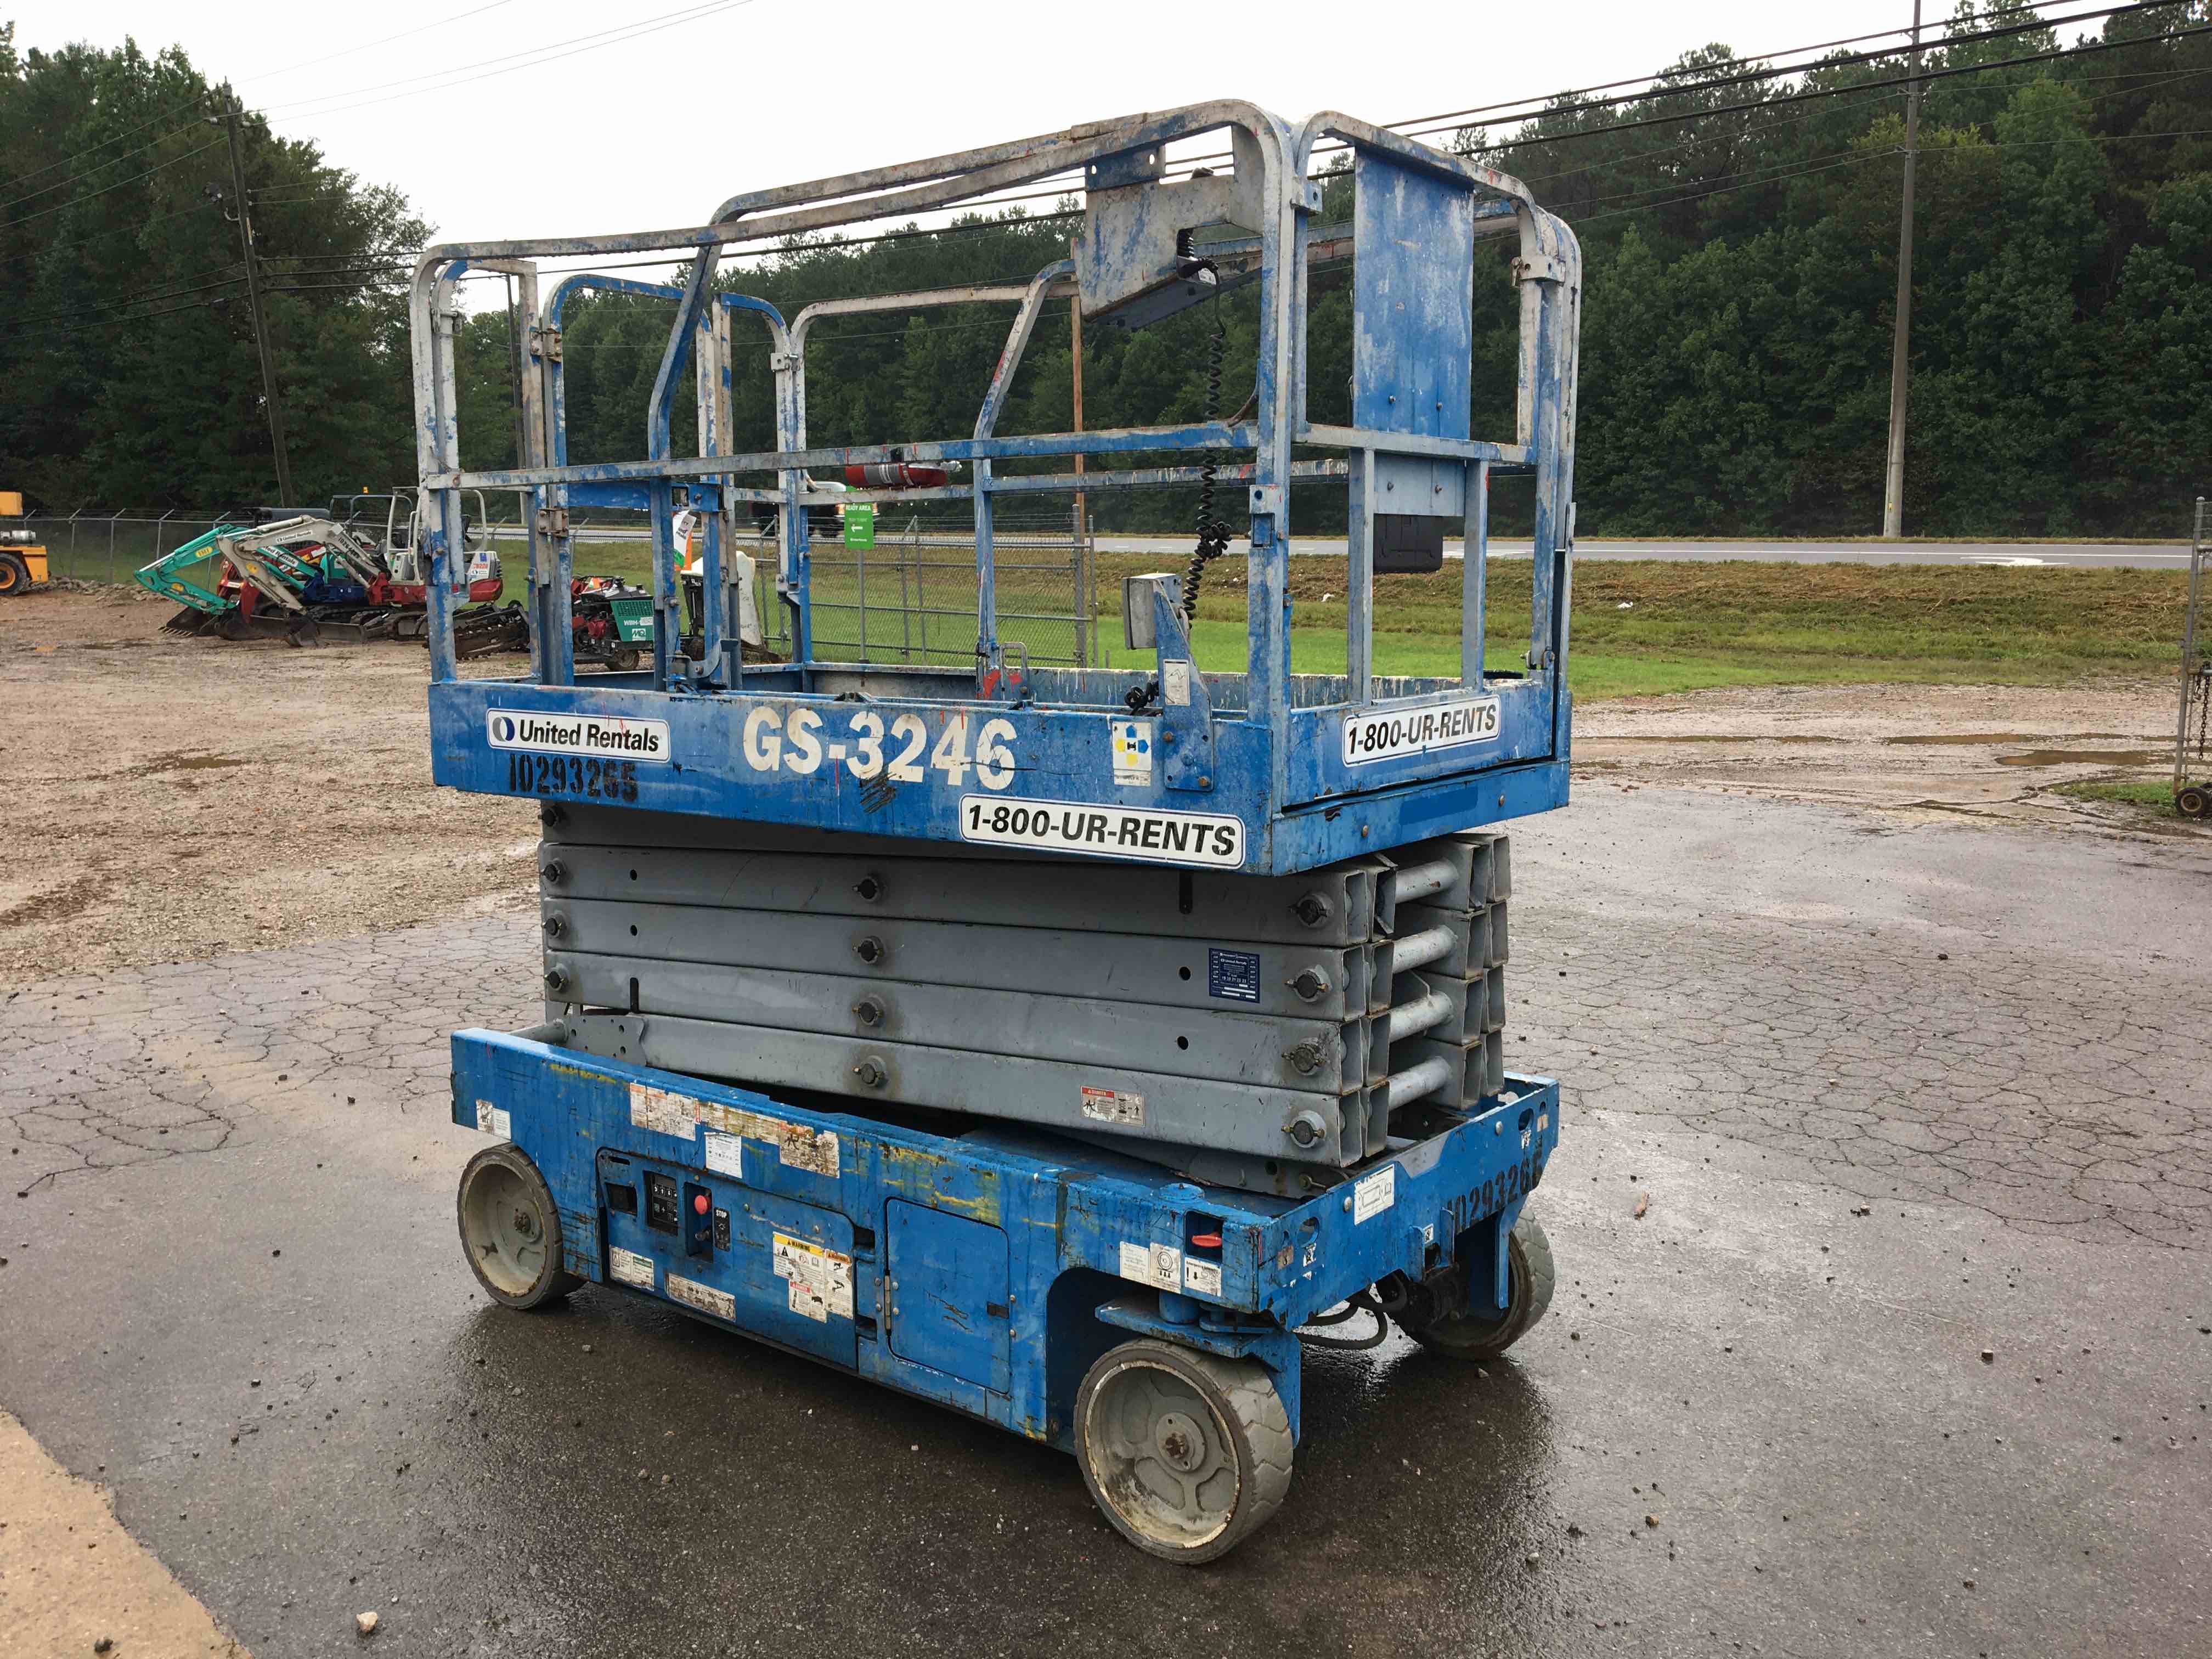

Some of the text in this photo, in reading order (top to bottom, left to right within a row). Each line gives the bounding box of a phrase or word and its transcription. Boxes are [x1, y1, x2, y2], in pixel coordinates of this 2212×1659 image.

[520, 719, 659, 752] United Rentals
[743, 706, 1018, 790] GS-3246
[1348, 704, 1497, 755] 1-800-UR-RENTS
[969, 804, 1236, 856] 1-800-UR-RENTS
[716, 1209, 727, 1218] STOP
